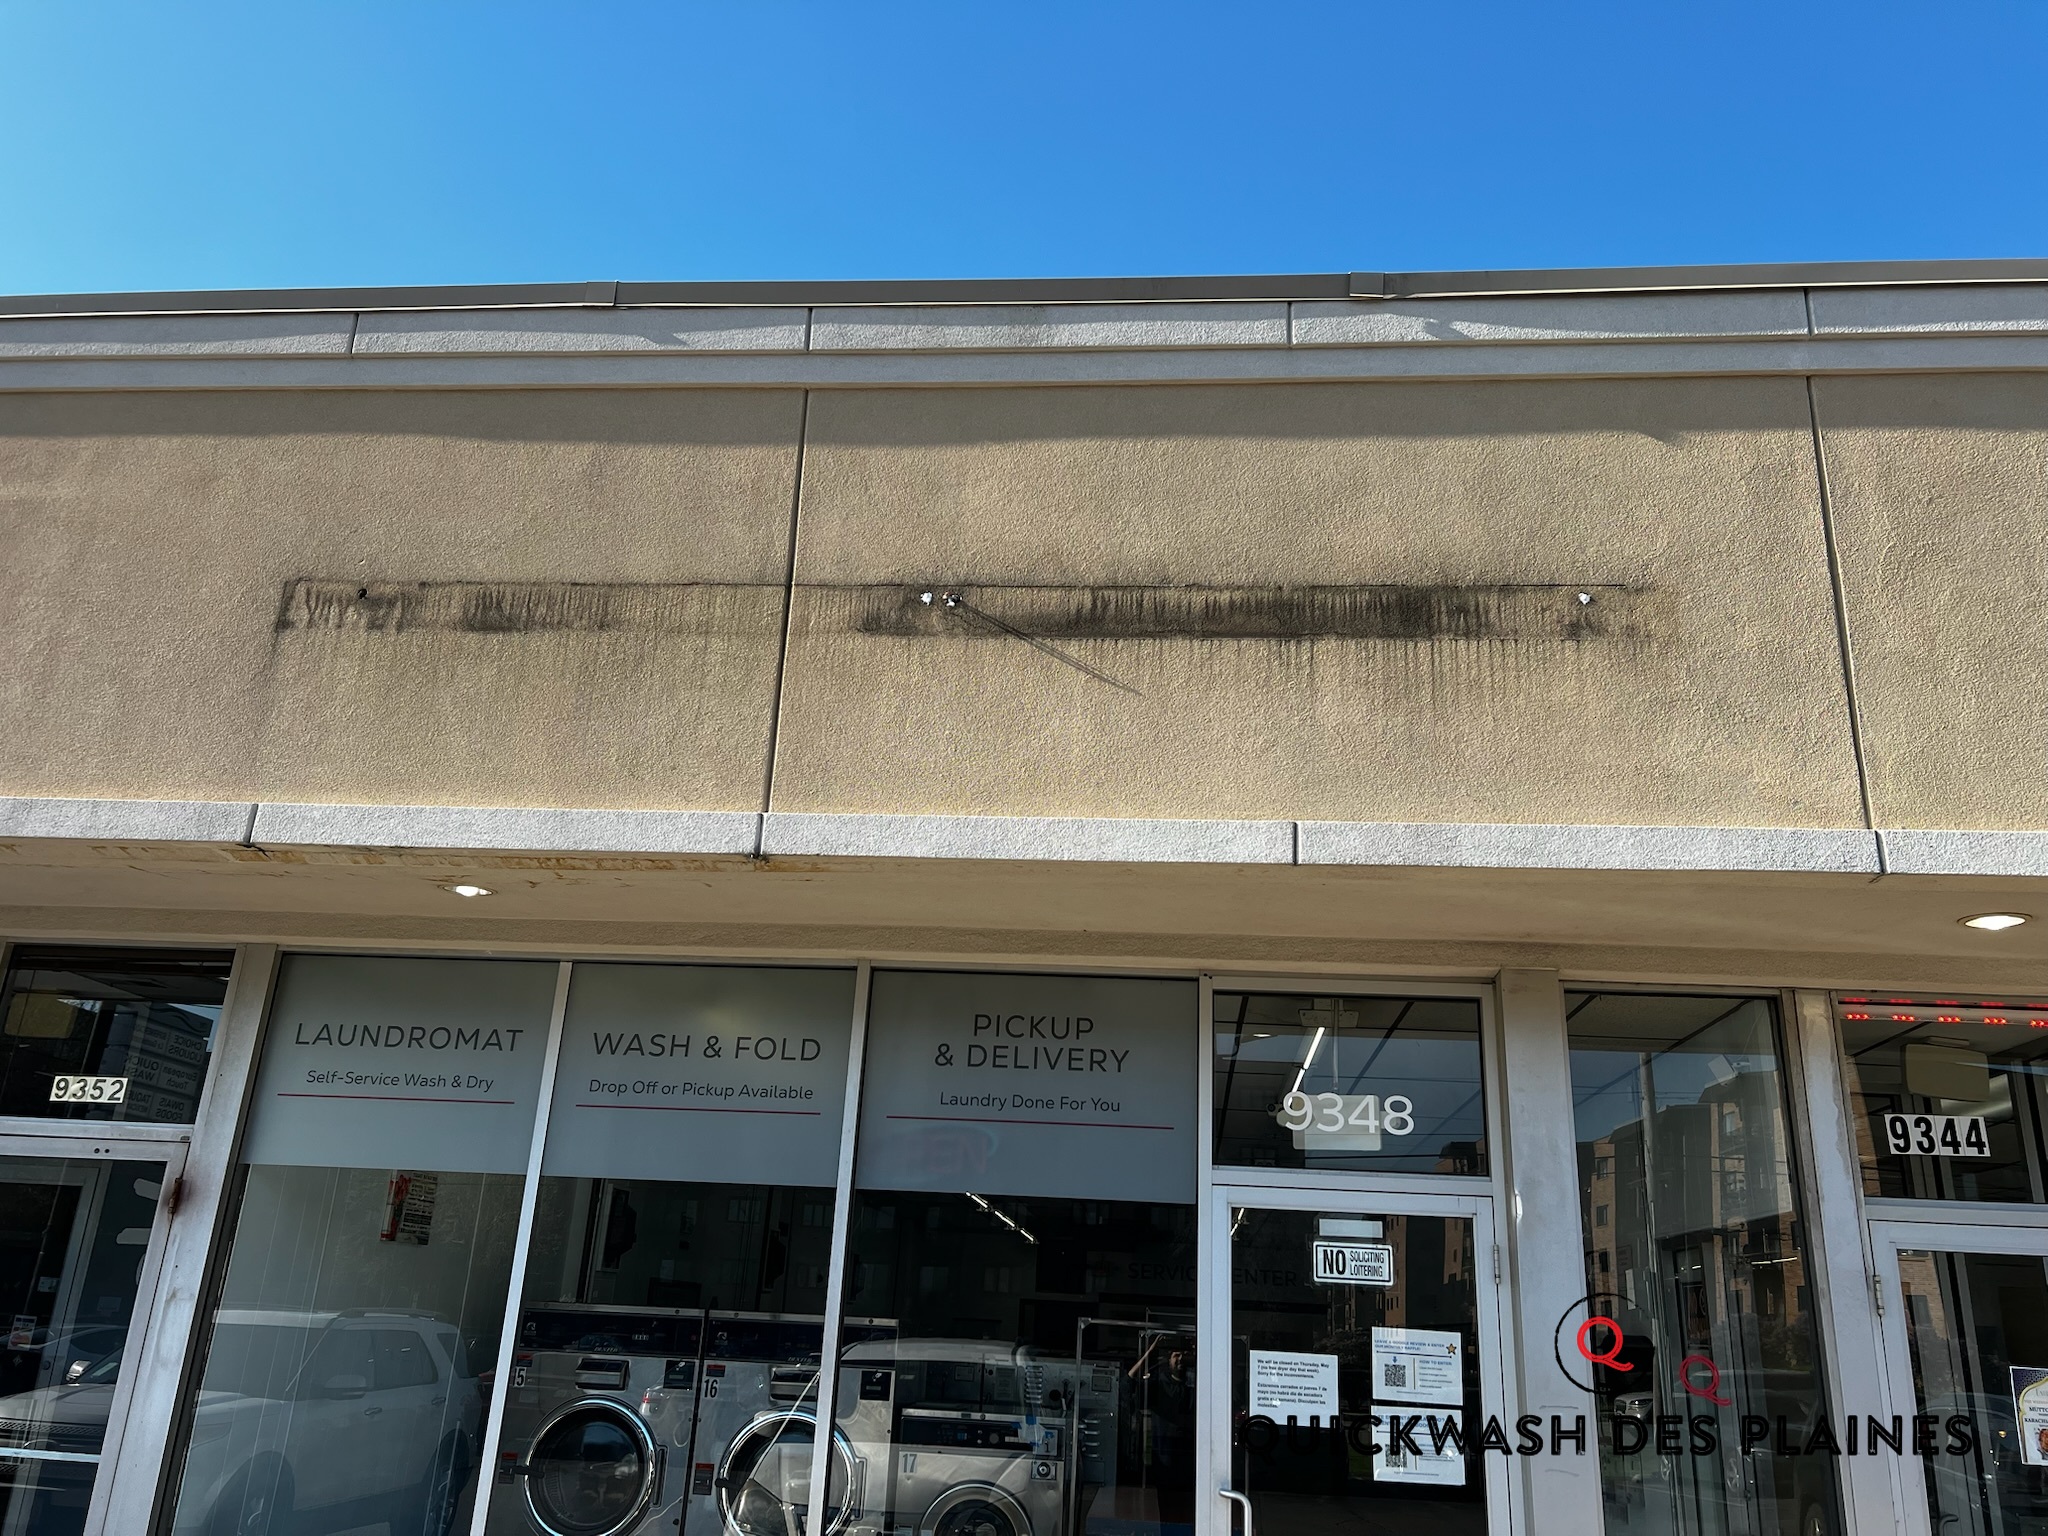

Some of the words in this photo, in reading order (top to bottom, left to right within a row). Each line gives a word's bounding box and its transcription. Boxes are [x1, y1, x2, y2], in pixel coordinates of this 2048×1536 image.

[296, 1023, 523, 1051] LAUNDROMAT
[974, 1014, 1093, 1039] PICKUP
[594, 1033, 690, 1057] WASH
[704, 1036, 721, 1058] &
[735, 1037, 820, 1061] FOLD
[935, 1044, 953, 1066] &
[968, 1045, 1129, 1072] DELIVERY
[54, 1077, 124, 1101] 9352
[307, 1070, 399, 1085] Self-Service
[405, 1074, 446, 1087] Wash
[453, 1074, 465, 1088] &
[469, 1075, 493, 1093] Dry
[590, 1080, 627, 1096] Drop
[633, 1081, 658, 1094] Off
[662, 1086, 678, 1094] or
[683, 1083, 734, 1100] Pickup
[738, 1085, 813, 1099] Available
[941, 1092, 1007, 1111] Laundry
[1013, 1095, 1054, 1109] Done
[1061, 1097, 1086, 1110] For
[1091, 1098, 1119, 1111] You
[1283, 1090, 1415, 1136] 9348
[1889, 1115, 1987, 1155] 9344
[1323, 1249, 1346, 1275] NO
[1350, 1250, 1385, 1263] SOLICITING
[1233, 1268, 1297, 1287] ENTER
[1350, 1264, 1383, 1277] LOITERING
[704, 1378, 718, 1398] 16
[902, 1453, 917, 1473] 17
